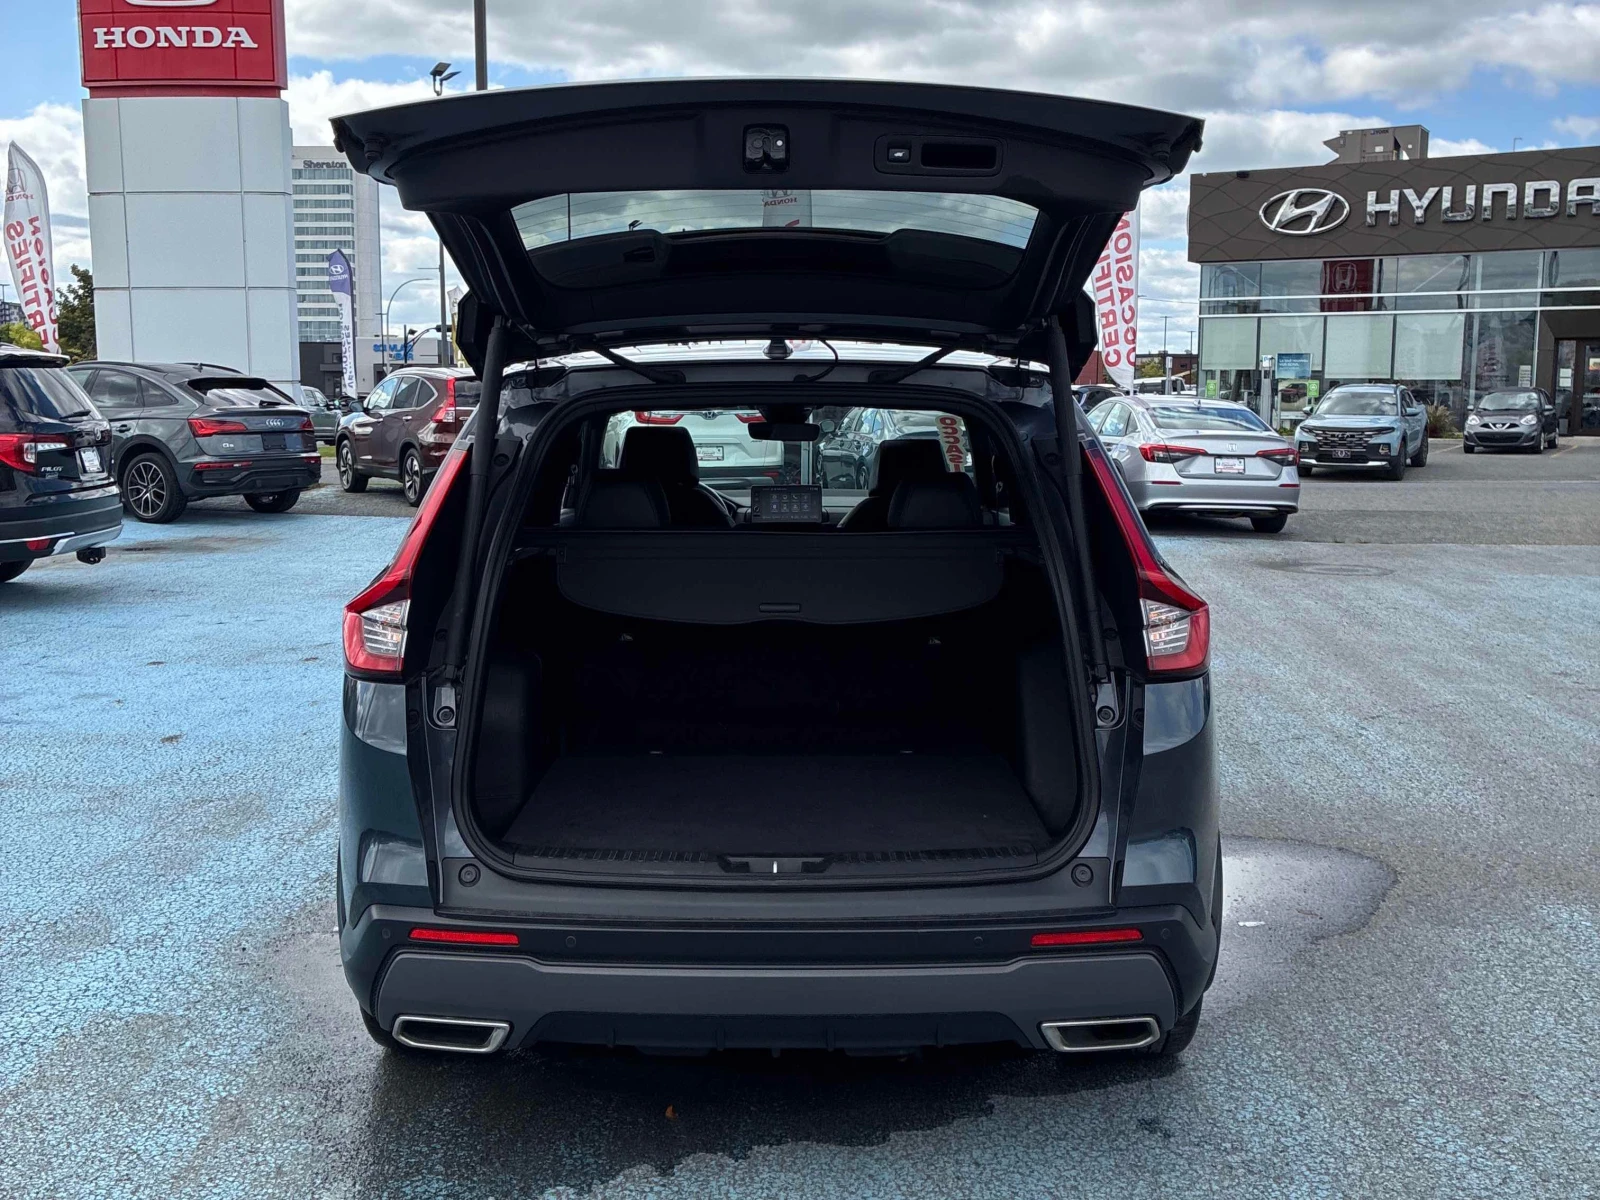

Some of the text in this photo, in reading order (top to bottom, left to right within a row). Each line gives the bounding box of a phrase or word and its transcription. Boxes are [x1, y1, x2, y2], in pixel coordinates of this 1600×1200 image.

[93, 26, 258, 49] HONDA
[303, 159, 347, 169] Sheraton
[1366, 177, 1600, 227] HYUNDA
